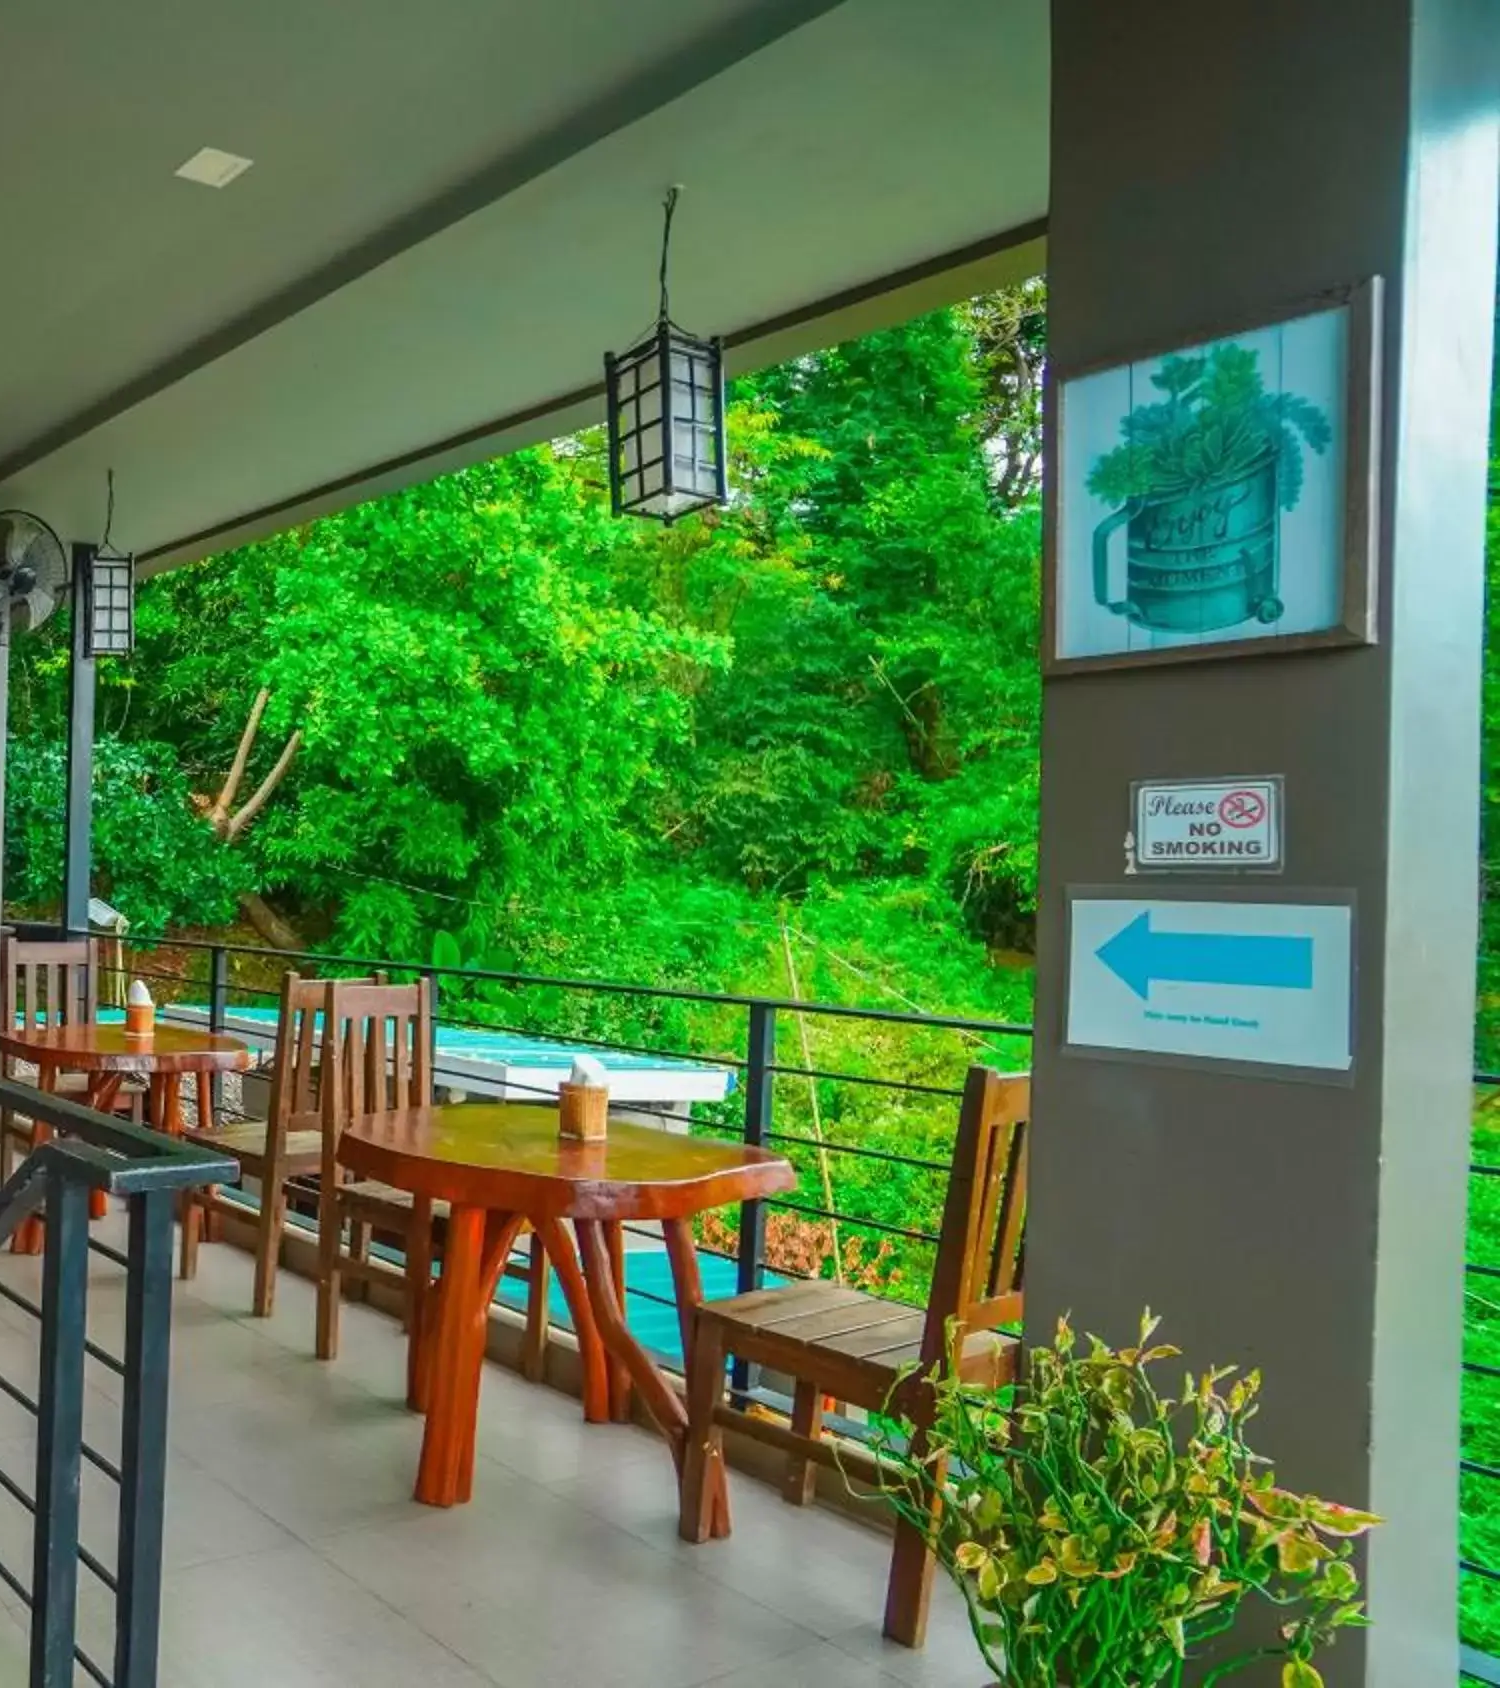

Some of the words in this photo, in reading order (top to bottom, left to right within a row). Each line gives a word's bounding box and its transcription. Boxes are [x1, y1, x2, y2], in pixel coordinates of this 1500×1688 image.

[1148, 795, 1215, 817] Please
[1189, 822, 1222, 836] NO
[1151, 841, 1262, 854] SMOKING
